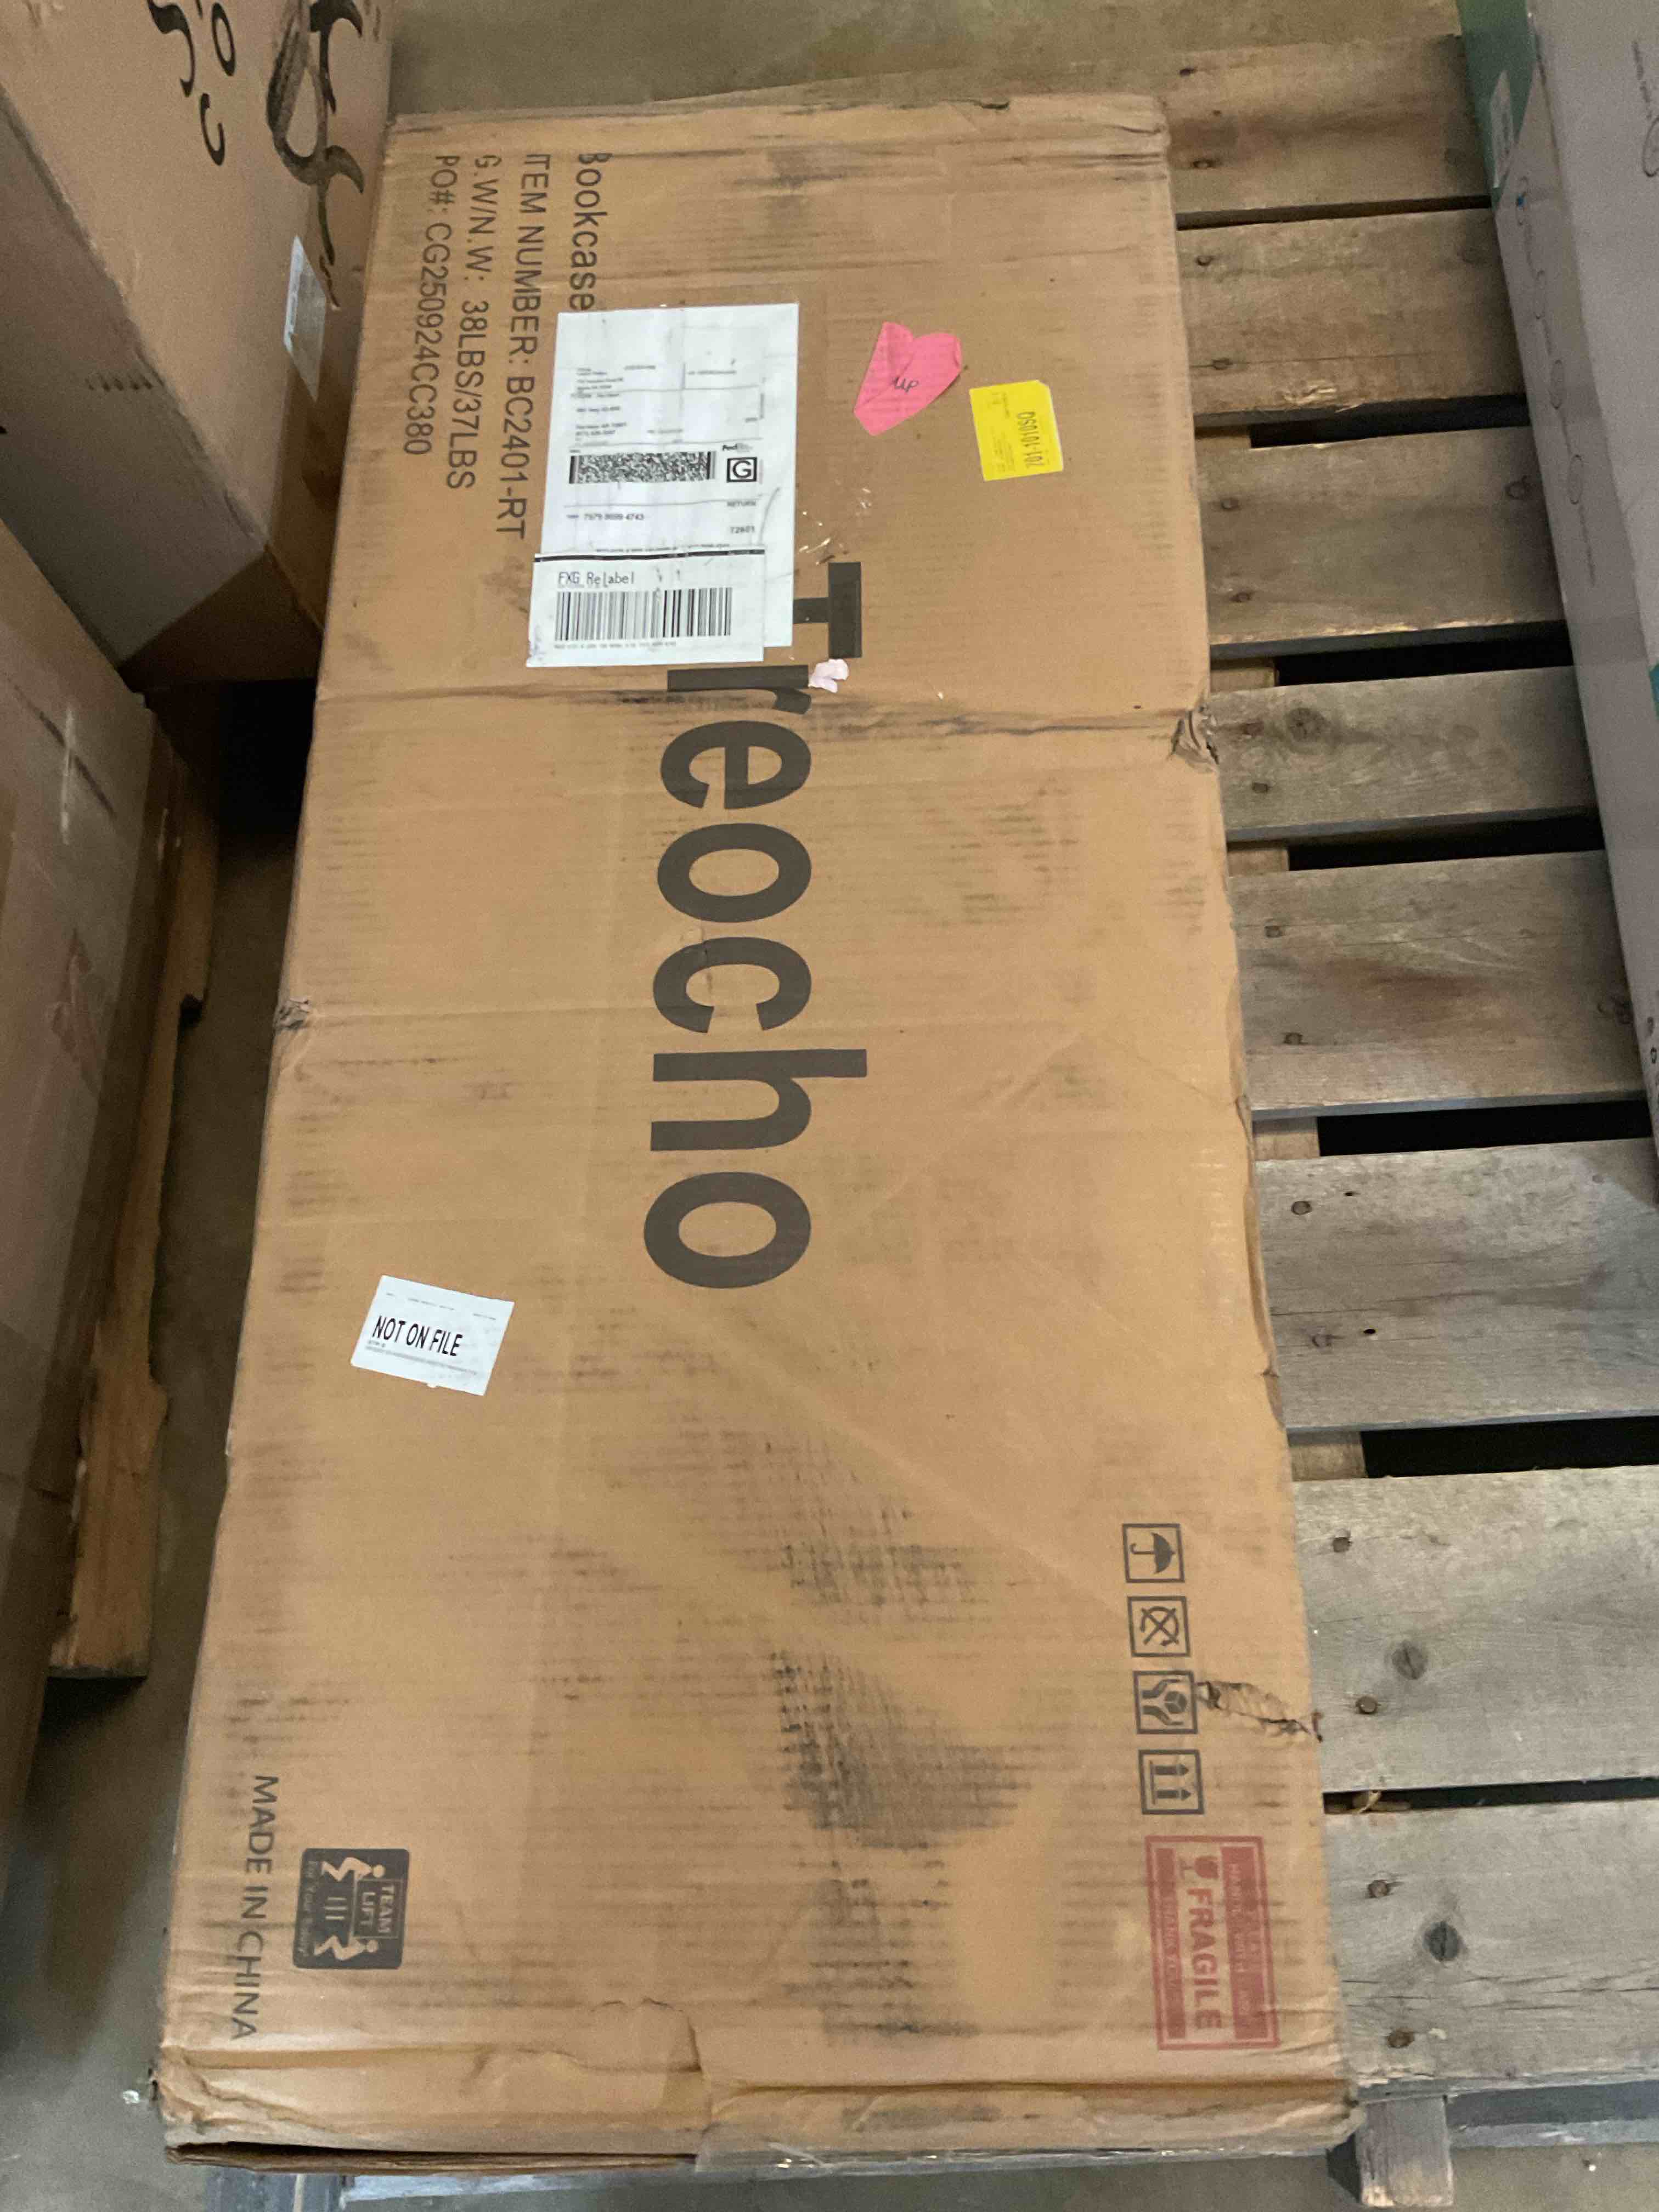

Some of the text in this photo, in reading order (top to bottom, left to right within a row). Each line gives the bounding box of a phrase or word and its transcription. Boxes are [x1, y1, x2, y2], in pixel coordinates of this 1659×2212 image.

[569, 153, 613, 311] Bookcase
[404, 222, 452, 455] CG250924CC380
[447, 300, 489, 489] 38LBS/37LBS
[496, 154, 551, 539] ITEM NUMBER: BC2401-RT
[732, 460, 752, 478] G
[558, 571, 580, 584] FXG
[644, 562, 867, 1289] Treocho
[372, 1315, 463, 1357] NOT ON FILE
[232, 1775, 279, 2040] MADE IN CHINA
[359, 1884, 395, 1933] TEAM LIFT
[1187, 1888, 1222, 2029] FRAGILE
